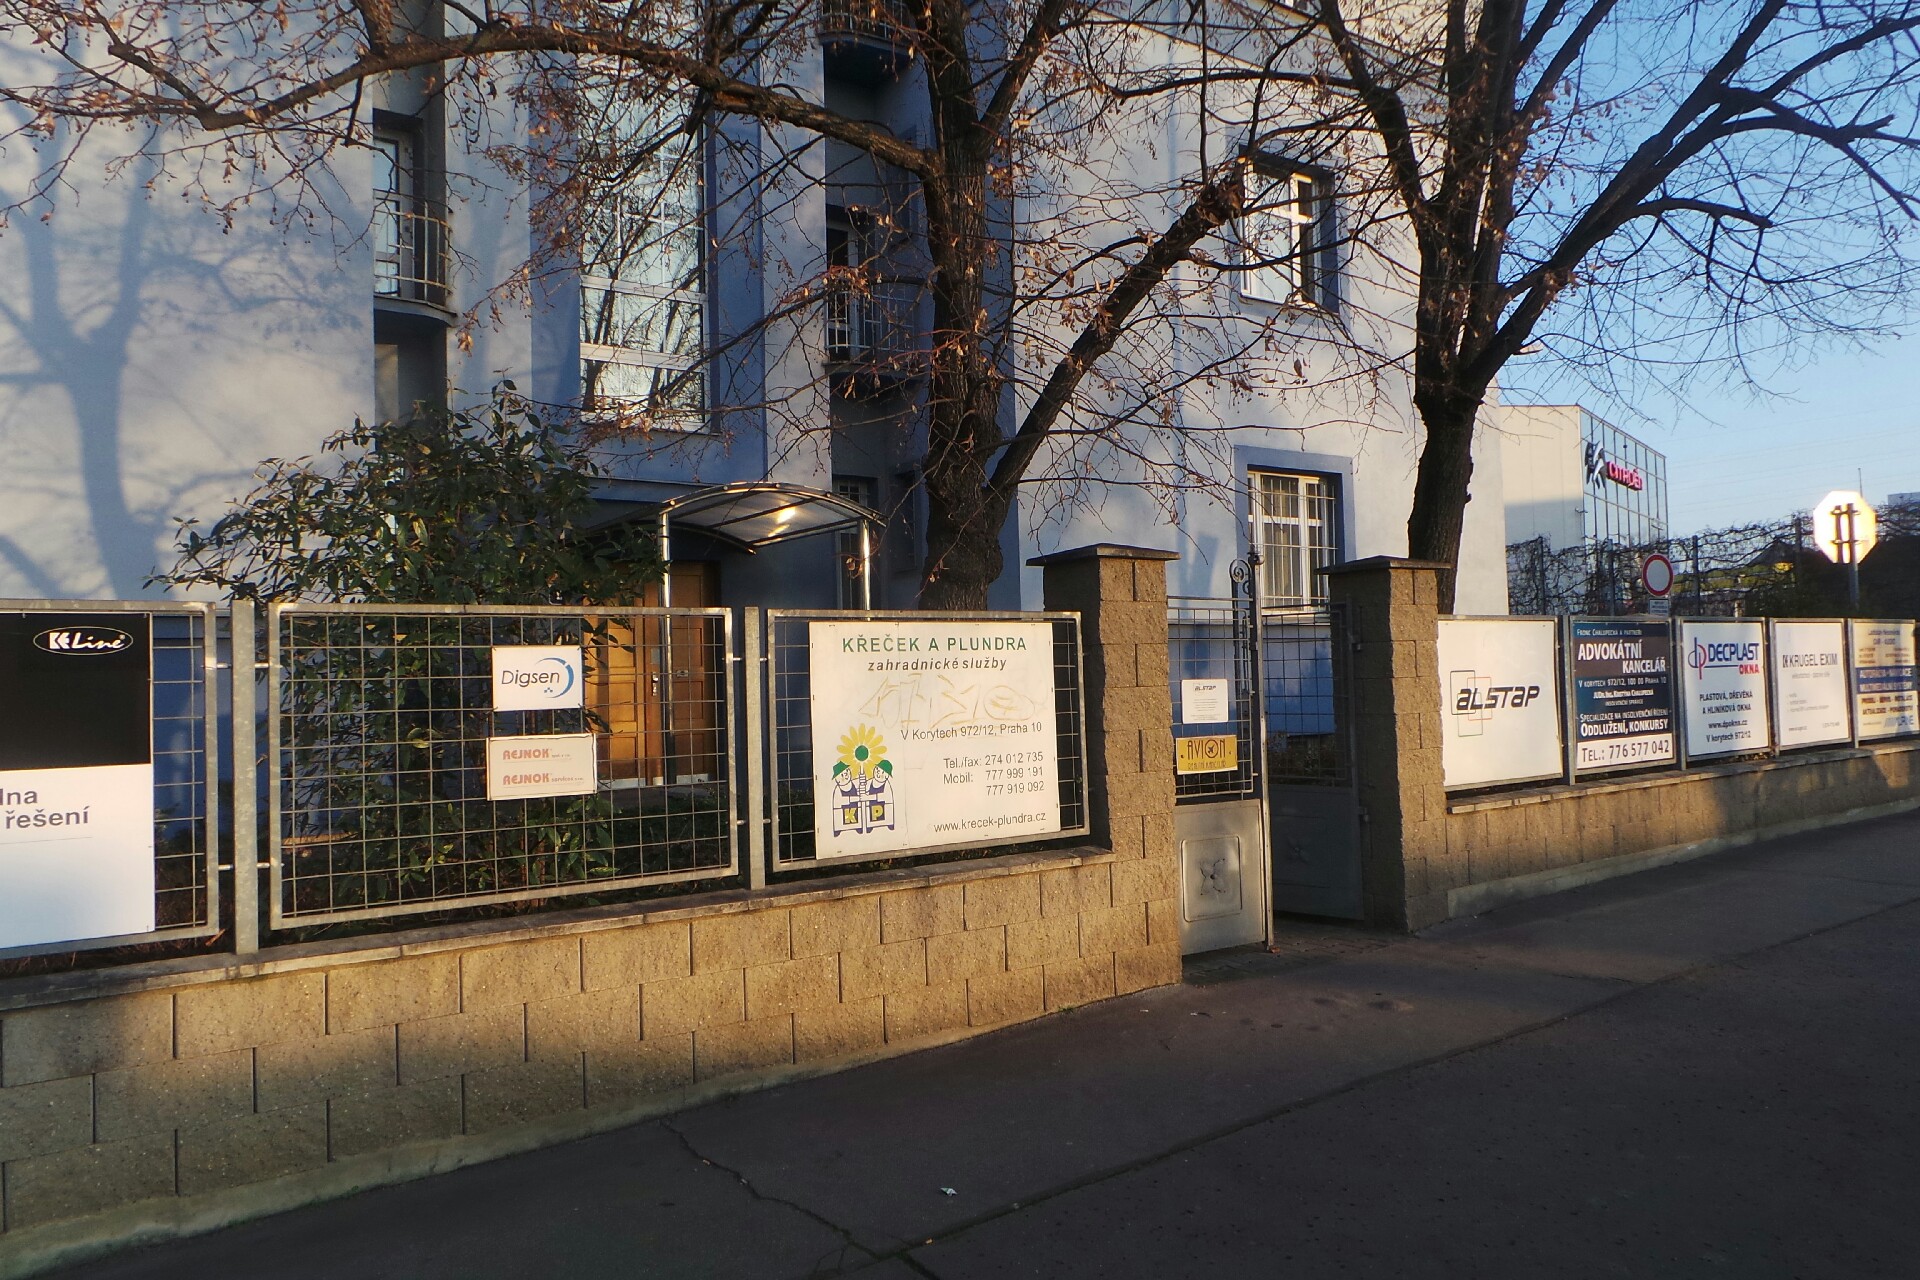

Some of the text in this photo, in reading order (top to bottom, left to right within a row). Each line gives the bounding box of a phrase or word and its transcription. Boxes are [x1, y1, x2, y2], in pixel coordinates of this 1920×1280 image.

[842, 634, 1027, 653] KŘEČEK A PLUNDRA
[1577, 639, 1643, 661] ADVOKÁTNÍ
[1708, 643, 1760, 662] DECPLAST
[868, 656, 1007, 671] zahradnické služby
[1622, 656, 1666, 674] KANCELÁŘ
[1739, 664, 1760, 675] OKNA
[1789, 654, 1818, 668] KRUGEL
[1820, 653, 1838, 666] EXIM
[501, 669, 560, 688] Digsen
[900, 721, 1042, 742] V Korytech 972/12, Praha 10
[1629, 718, 1669, 733] KONKURSY
[1187, 738, 1226, 760] AVION
[1609, 744, 1628, 759] 776
[1631, 742, 1649, 756] 577
[1651, 740, 1669, 754] 042
[943, 751, 1044, 769] Tel./fax: 274 012 735
[943, 766, 1044, 784] Mobil: 777 999 191
[986, 781, 1045, 796] 777 919 092
[5, 805, 90, 829] řešení
[844, 807, 857, 824] K
[871, 805, 883, 820] P
[933, 812, 1047, 833] www.krecek-plundra.cz
